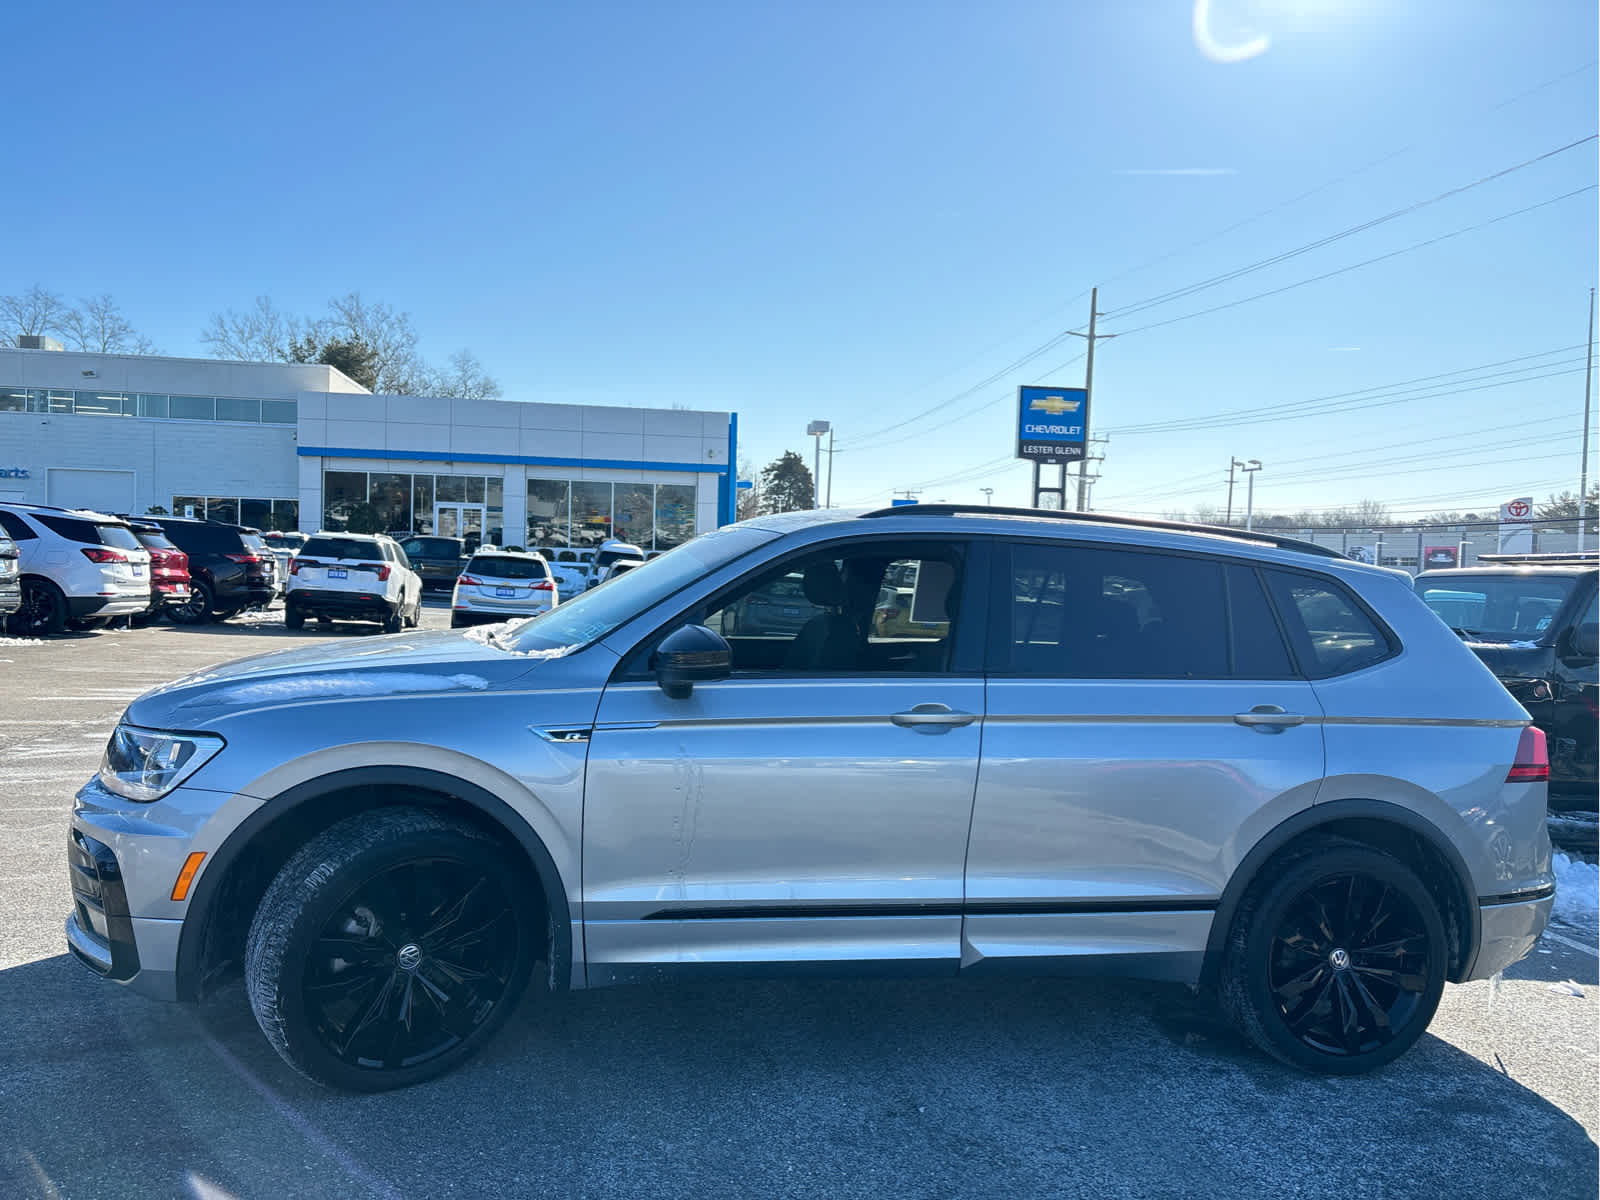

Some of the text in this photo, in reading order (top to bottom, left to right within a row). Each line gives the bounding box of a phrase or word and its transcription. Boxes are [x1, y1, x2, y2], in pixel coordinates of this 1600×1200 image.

[1024, 424, 1081, 435] CHEVROLET
[1023, 445, 1081, 455] LESTER GLENN
